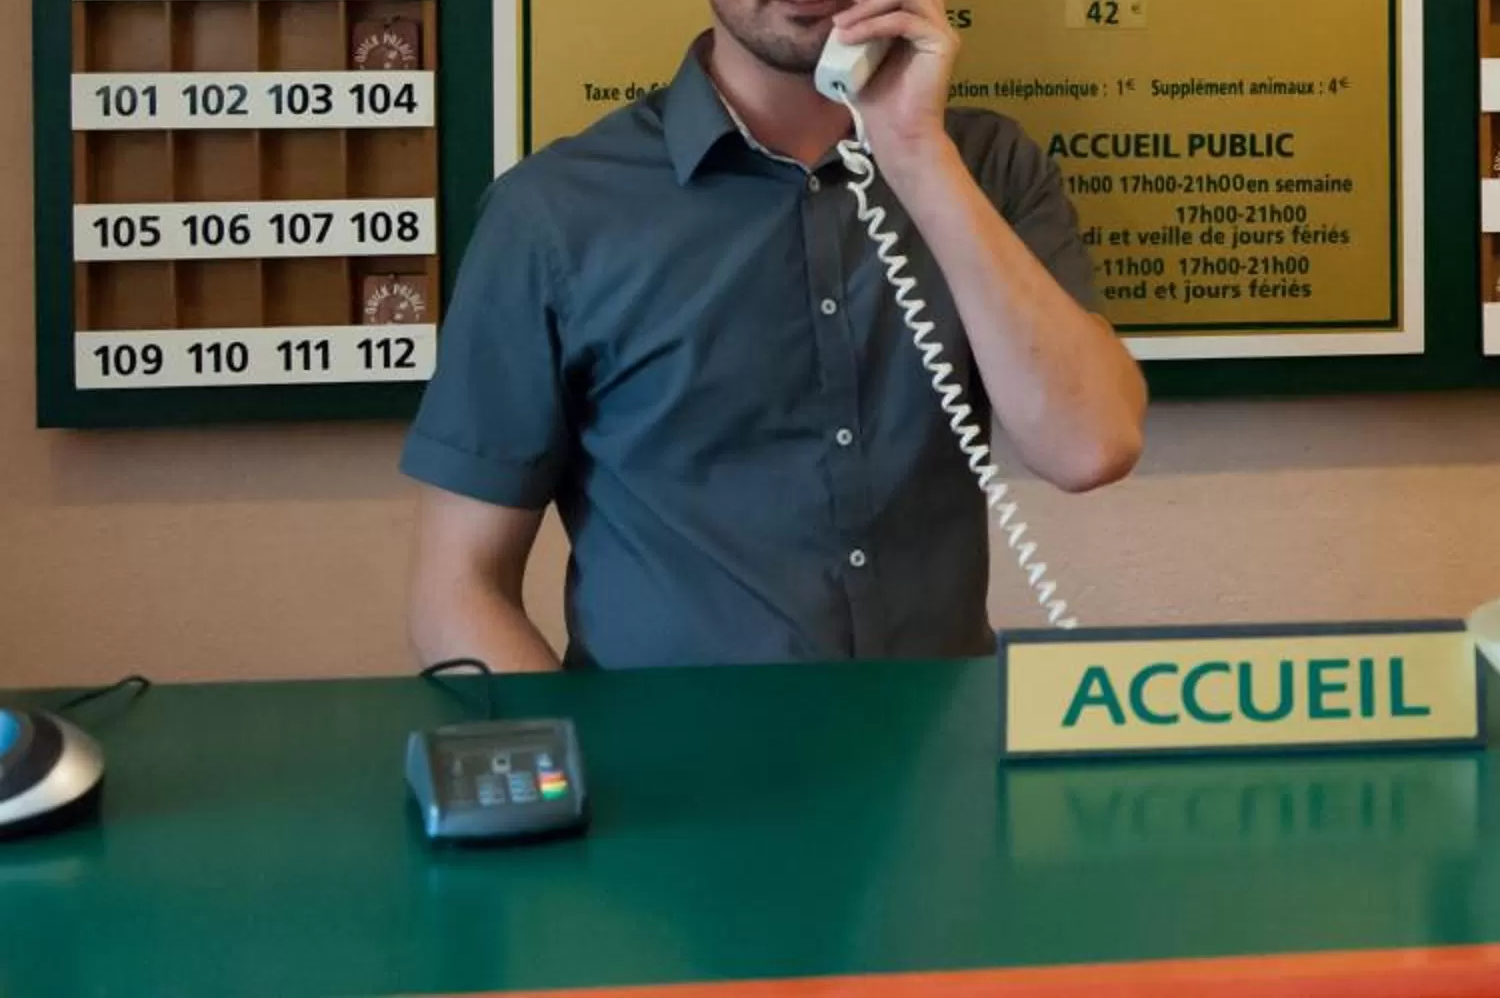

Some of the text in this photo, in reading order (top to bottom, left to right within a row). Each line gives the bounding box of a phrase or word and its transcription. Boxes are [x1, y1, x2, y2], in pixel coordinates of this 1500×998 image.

[1087, 2, 1119, 25] 42
[95, 83, 418, 117] 101 102 103 104
[584, 83, 619, 101] Taxe
[994, 79, 1099, 100] téléphonique
[1151, 78, 1244, 100] Supplément
[1249, 77, 1315, 96] animaux
[1049, 133, 1295, 159] ACCUEIL PUBLIC
[1060, 174, 1113, 194] 1h00
[1275, 173, 1353, 193] semaine
[1176, 204, 1307, 224] 17h00-21h00
[92, 211, 419, 248] 105 106 107 108
[1081, 223, 1350, 250] di et veille de jours fériés
[1179, 255, 1310, 276] 17h00-21h00
[1104, 278, 1313, 305] end et jours fériés
[93, 337, 416, 376] 109 110 111 112
[1061, 657, 1431, 728] ACCUEIL
